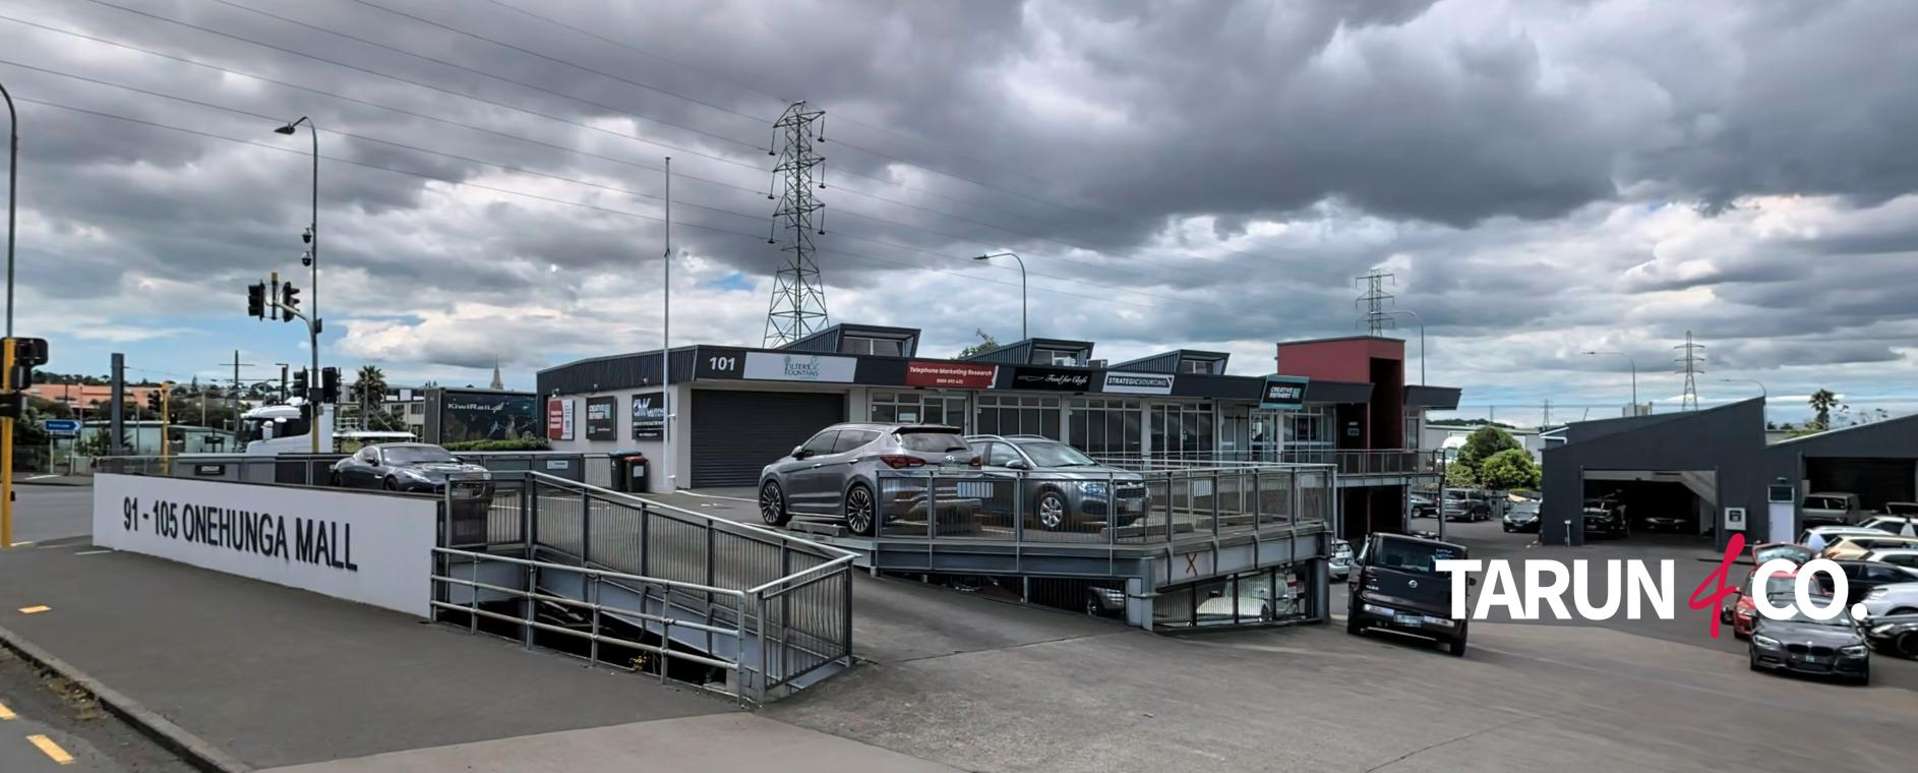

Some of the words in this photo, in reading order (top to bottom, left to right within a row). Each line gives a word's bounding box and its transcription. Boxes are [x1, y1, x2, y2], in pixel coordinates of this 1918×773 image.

[709, 356, 735, 371] 101
[910, 367, 939, 375] Telephone
[939, 368, 967, 377] Marketing
[1045, 374, 1062, 384] Food
[124, 497, 138, 531] 91
[153, 500, 178, 539] 105
[183, 503, 289, 560] ONEHUNGA
[296, 517, 358, 572] MALL
